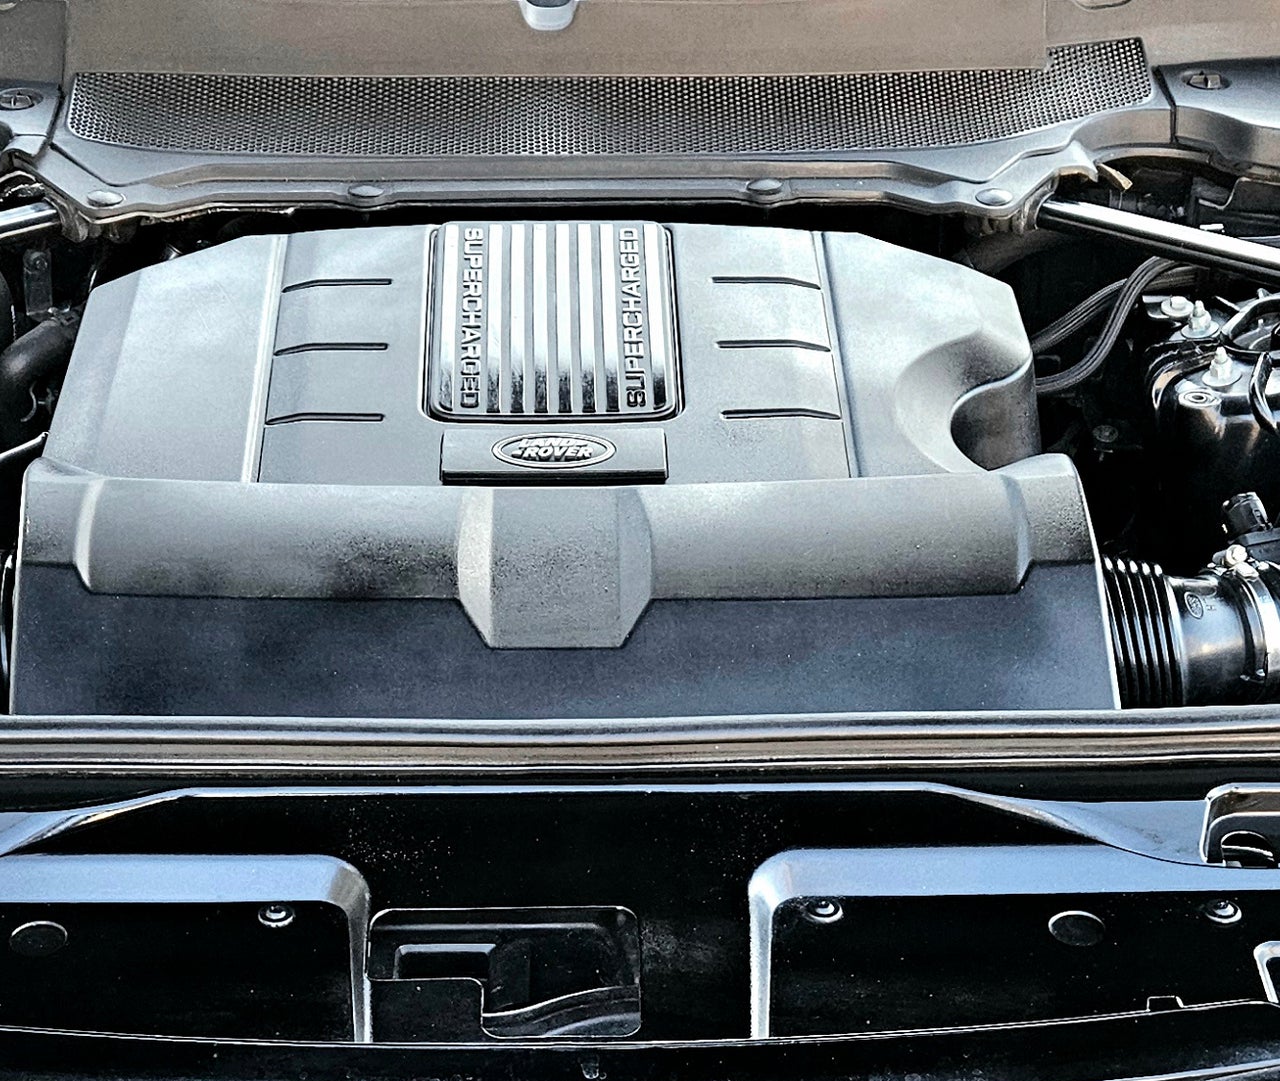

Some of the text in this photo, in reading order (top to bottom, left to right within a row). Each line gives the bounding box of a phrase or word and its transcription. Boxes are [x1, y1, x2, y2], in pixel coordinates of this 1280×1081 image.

[460, 227, 484, 409] SUPERCHARGED
[619, 227, 646, 408] SUPERCHARGED
[519, 437, 577, 448] LAND
[522, 446, 594, 460] ROVER
